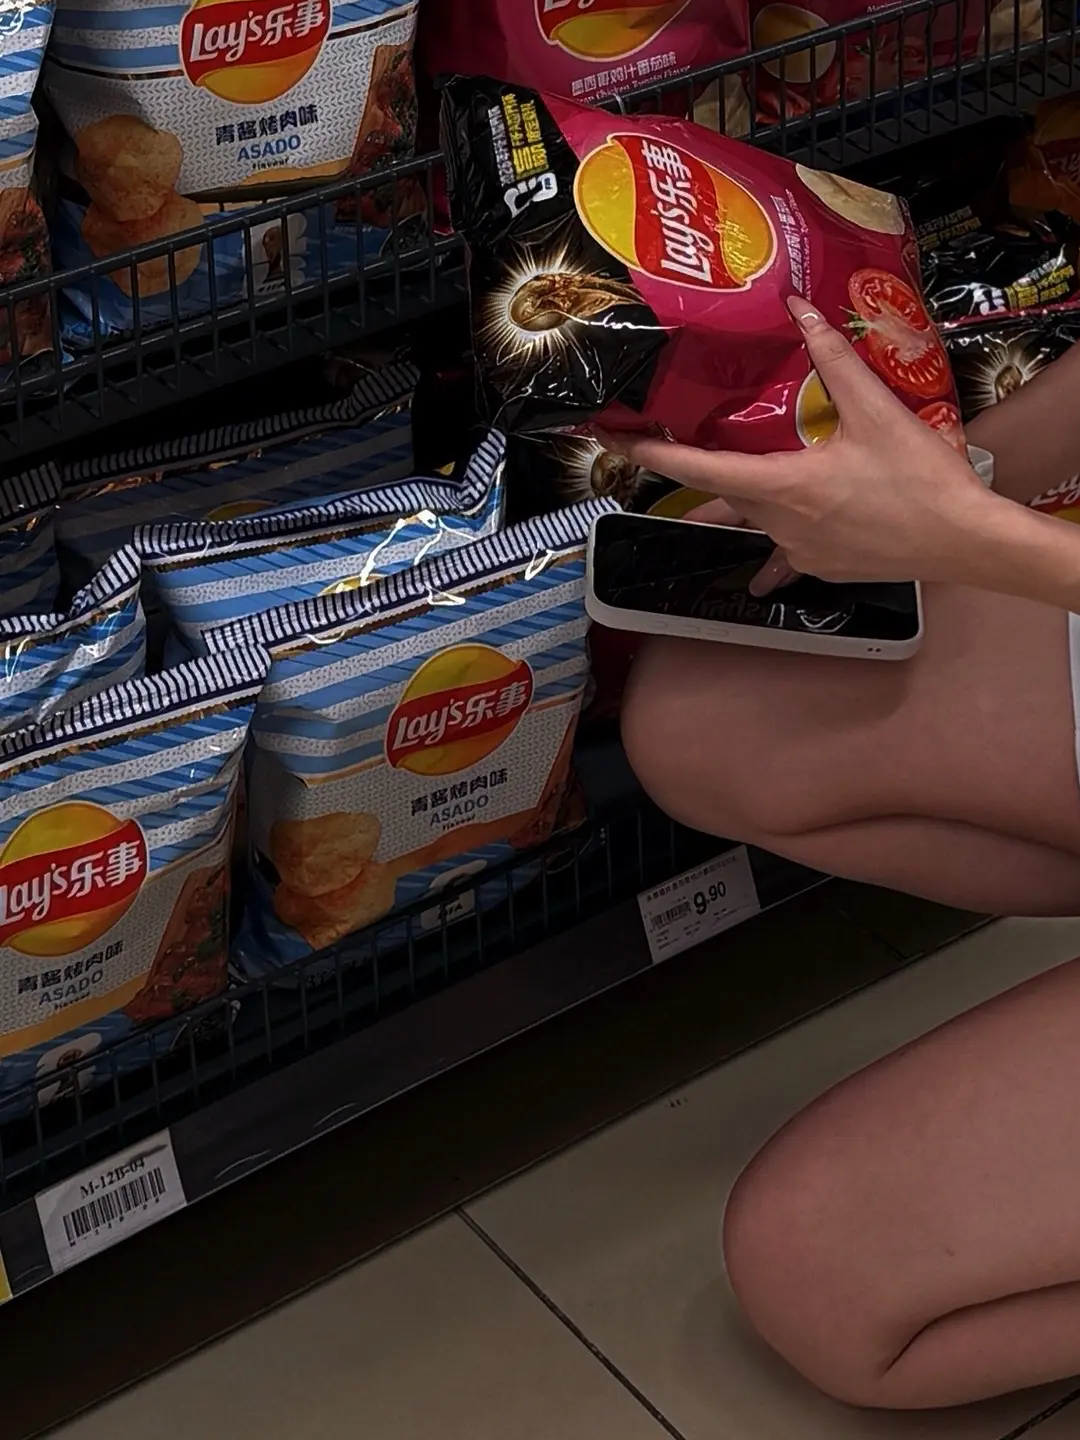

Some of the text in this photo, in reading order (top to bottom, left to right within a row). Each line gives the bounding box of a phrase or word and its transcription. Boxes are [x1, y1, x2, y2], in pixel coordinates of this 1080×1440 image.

[215, 104, 319, 146] 青酱烤肉味
[237, 135, 301, 162] ASADO
[410, 767, 509, 816] 青酱烤肉味
[429, 793, 489, 828] ASADO
[693, 881, 726, 916] 9.90
[18, 940, 124, 994] 青酱烤肉味
[39, 970, 104, 1005] ASADO
[80, 1157, 145, 1199] M-12B-04
